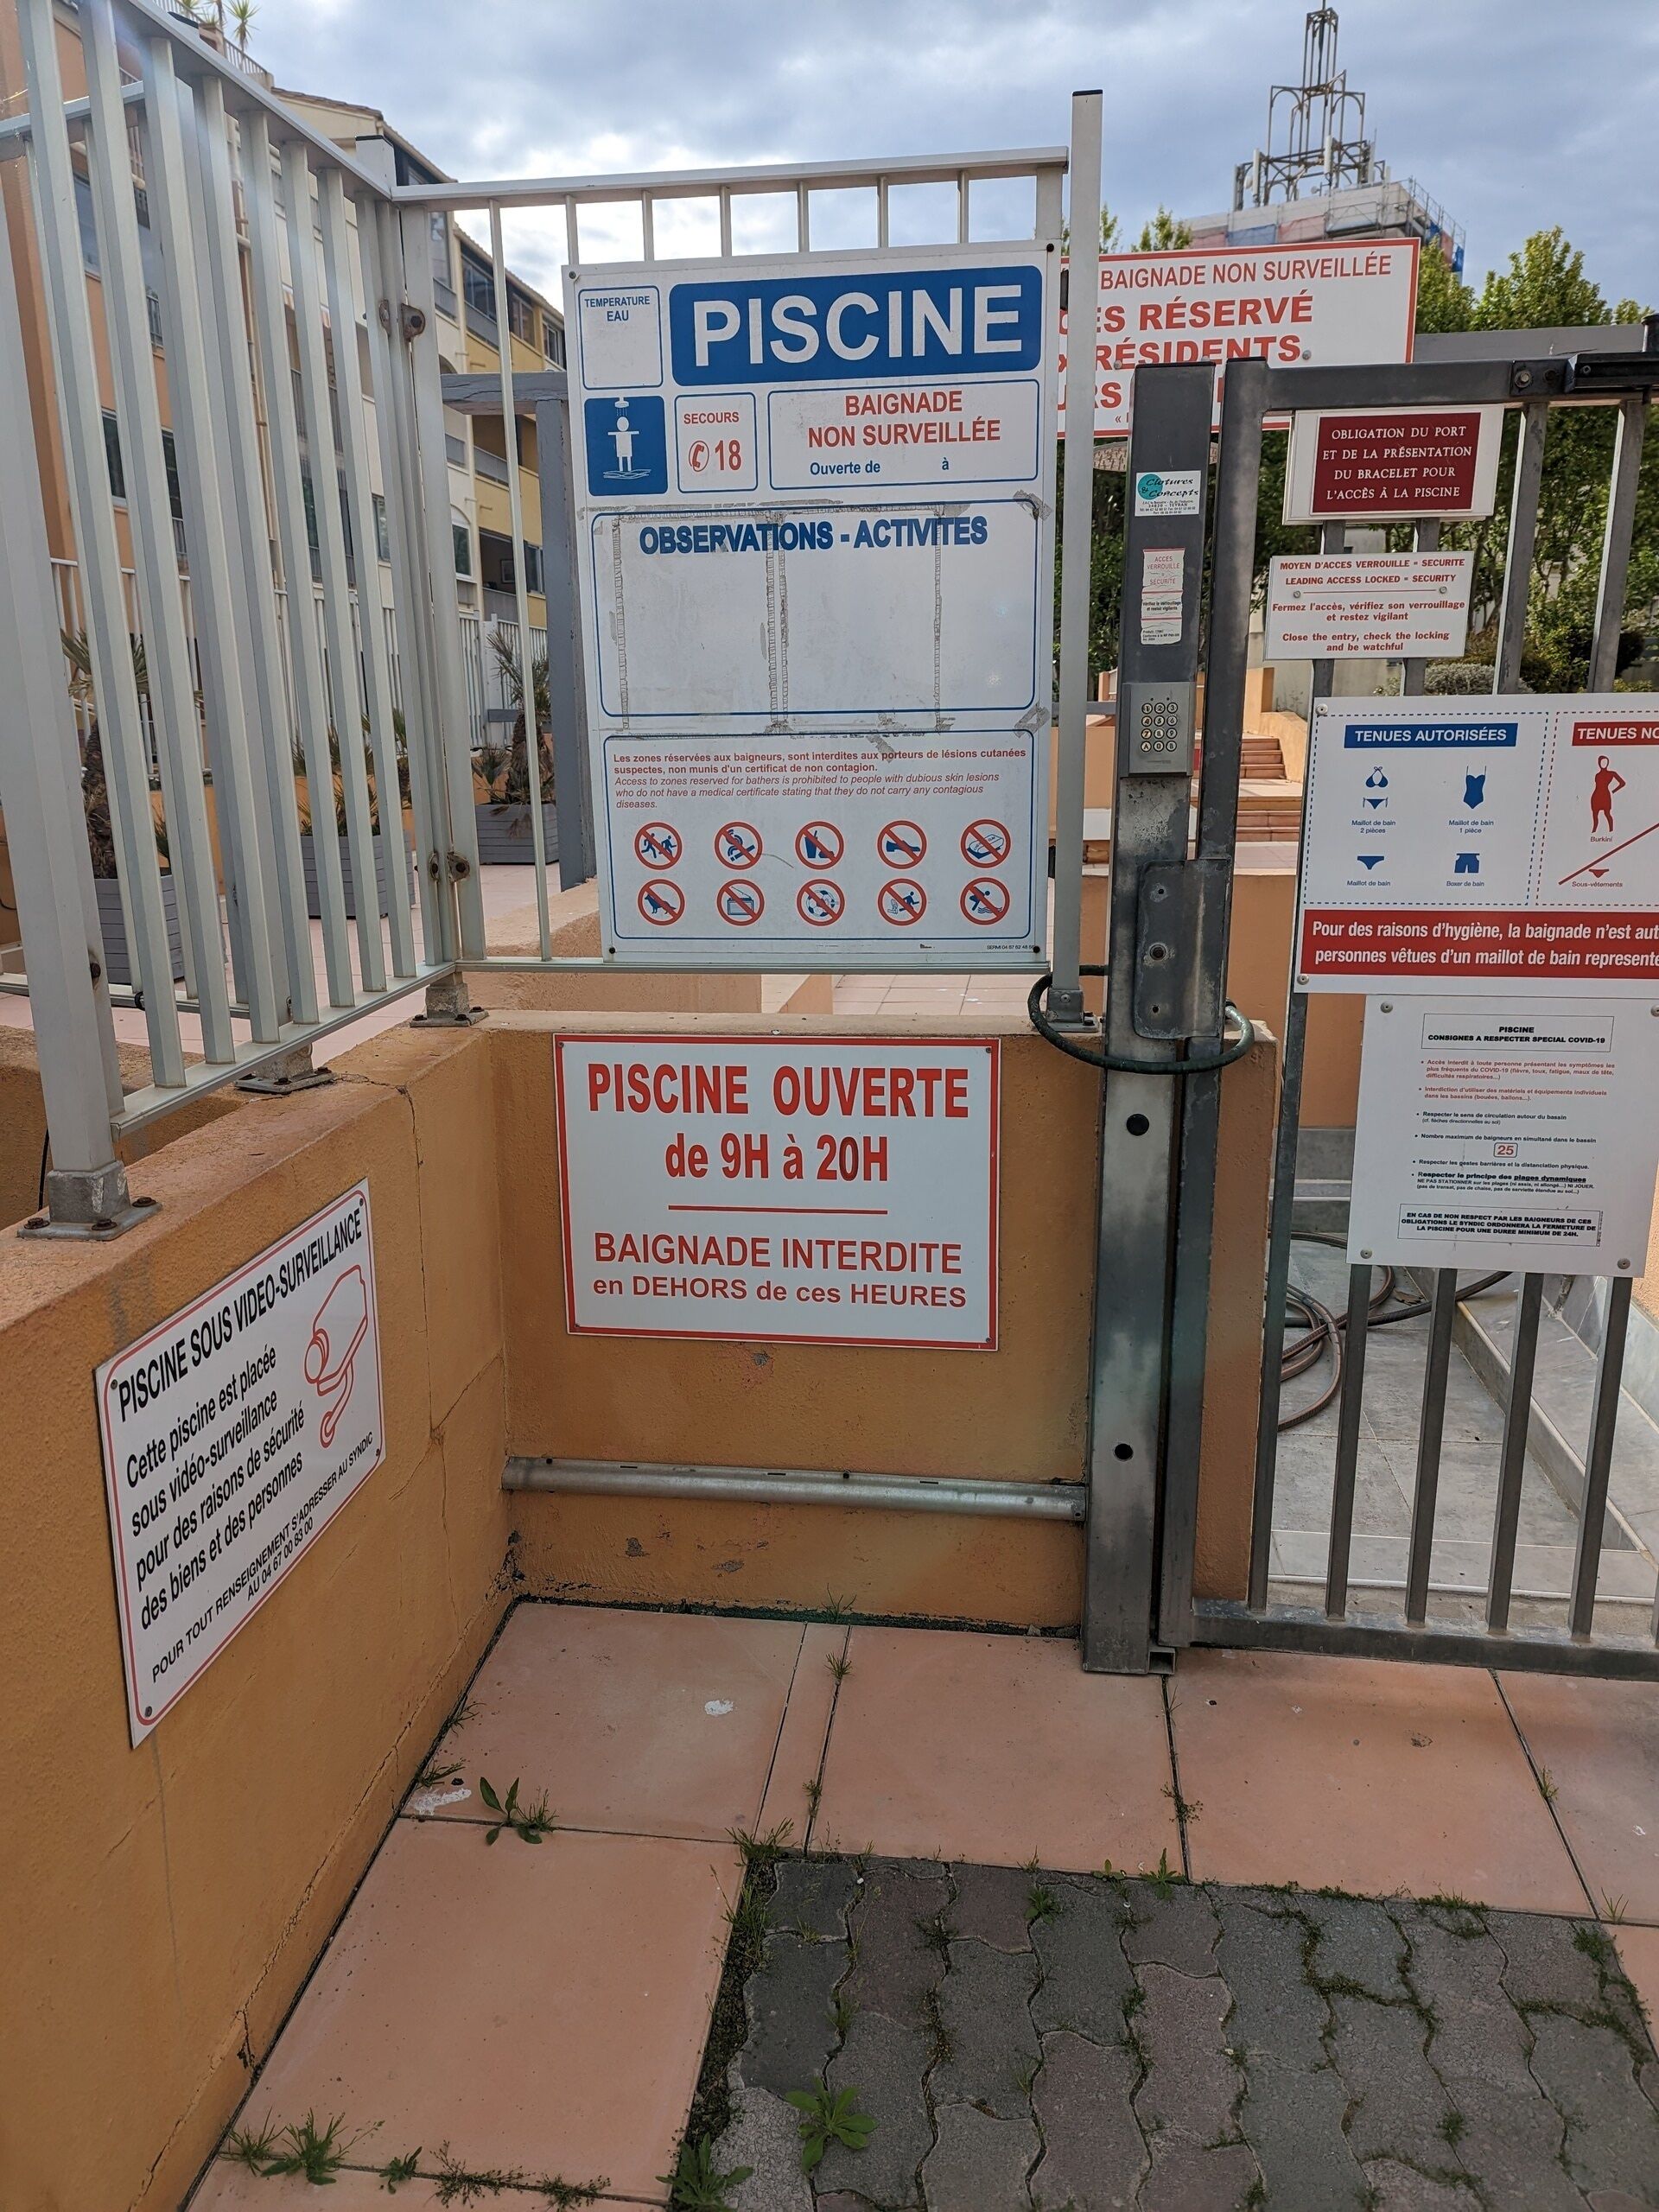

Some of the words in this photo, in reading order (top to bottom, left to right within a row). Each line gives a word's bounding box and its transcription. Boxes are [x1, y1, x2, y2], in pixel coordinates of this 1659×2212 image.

[1101, 264, 1205, 289] BAIGNADE
[1212, 262, 1255, 283] NON
[1263, 252, 1391, 281] SURVEILLÉE
[584, 296, 650, 308] TEMPERATURE
[1140, 289, 1313, 331] RÉSERVÉ
[607, 309, 628, 321] EAU
[694, 284, 1021, 366] PISCINE
[845, 391, 962, 416] BAIGNADE
[683, 411, 739, 424] SECOURS
[808, 425, 855, 448] NON
[862, 416, 1000, 445] SURVEILLÉE
[1332, 428, 1404, 439] OBLIGATION
[1410, 427, 1428, 437] DU
[1434, 426, 1466, 436] PORT
[715, 440, 741, 470] 18
[1323, 449, 1337, 460] ET
[1342, 449, 1357, 459] DE
[1363, 448, 1378, 459] LA
[1383, 446, 1471, 458] PRÉSENTATION
[810, 461, 861, 475] Ouverte
[865, 460, 880, 473] de
[942, 457, 949, 470] à
[1334, 469, 1351, 480] DU
[1357, 467, 1417, 479] BRACELET
[1422, 467, 1455, 477] POUR
[1326, 486, 1374, 499] L'ACCÈS
[1379, 486, 1388, 498] À
[1394, 488, 1408, 498] LA
[1414, 486, 1459, 497] PISCINE
[639, 521, 833, 554] OBSERVATIONS
[1356, 559, 1409, 568] VERROUILLE
[1285, 576, 1323, 585] LEADING
[1326, 575, 1361, 584] ACCESS
[1412, 574, 1456, 582] SECURITY
[1310, 601, 1344, 611] l'accès,
[1349, 601, 1383, 610] vérifiez
[1408, 600, 1465, 609] verrouillage
[1373, 612, 1408, 621] vigilant
[1355, 730, 1411, 741] TENUES
[1414, 726, 1506, 741] AUTORISÉES
[1577, 728, 1637, 739] TENUES
[664, 753, 710, 761] réservées
[734, 753, 785, 763] baigneurs,
[811, 751, 857, 760] interdites
[861, 751, 879, 760] aux
[881, 750, 924, 762] porteurs
[926, 749, 938, 758] de
[941, 749, 977, 758] lésions
[980, 747, 1026, 757] cutanées
[1313, 921, 1344, 936] Pour
[1348, 921, 1373, 937] des
[1377, 922, 1427, 937] raisons
[1433, 922, 1503, 940] d'hygiène,
[1508, 923, 1520, 938] la
[1525, 923, 1591, 941] baignade
[1595, 924, 1631, 939] n'est
[1635, 925, 1659, 939] aut
[1315, 950, 1386, 964] personnes
[1391, 949, 1436, 963] vêtues
[1440, 949, 1471, 963] d'un
[1475, 950, 1523, 964] maillot
[1528, 950, 1545, 964] de
[1549, 950, 1580, 964] bain
[588, 1063, 748, 1114] PISCINE
[773, 1065, 968, 1117] OUVERTE
[665, 1133, 708, 1178] de
[721, 1133, 768, 1178] 9H
[783, 1133, 804, 1179] à
[817, 1134, 887, 1181] 20H
[1497, 1145, 1514, 1155] 25
[594, 1232, 770, 1267] BAIGNADE
[783, 1238, 961, 1274] INTERDITE
[594, 1280, 622, 1294] en
[632, 1275, 747, 1299] DEHORS
[756, 1280, 786, 1300] de
[796, 1287, 840, 1303] ces
[851, 1283, 965, 1307] HEURES
[118, 1338, 188, 1421] PISCINE
[190, 1306, 232, 1365] SOUS
[233, 1208, 361, 1331] VIDEO-SURVEILLANCE
[127, 1439, 166, 1487] Cette
[169, 1397, 215, 1456] piscine
[219, 1375, 238, 1411] est
[239, 1347, 276, 1400] placée
[132, 1489, 166, 1536] sous
[168, 1390, 276, 1502] vidéo-surveillance
[137, 1534, 168, 1592] pour
[173, 1510, 197, 1548] des
[200, 1465, 244, 1524] raisons
[246, 1448, 261, 1478] de
[263, 1405, 304, 1462] sécurité
[141, 1587, 167, 1630] des
[169, 1549, 206, 1601] biens
[209, 1529, 222, 1561] et
[224, 1510, 245, 1546] des
[248, 1452, 302, 1529] personnes
[152, 1639, 184, 1682] POUR
[185, 1605, 213, 1644] TOUT
[215, 1522, 289, 1615] RENSEIGNEMENT
[291, 1471, 337, 1530] S'ADRESSER
[338, 1459, 347, 1479] AU
[348, 1432, 372, 1466] SYNDIC
[247, 1576, 259, 1601] AU
[261, 1564, 271, 1584] 04
[273, 1551, 282, 1571] 67
[283, 1540, 293, 1558] 00
[294, 1529, 303, 1547] 83
[304, 1517, 313, 1535] 00
